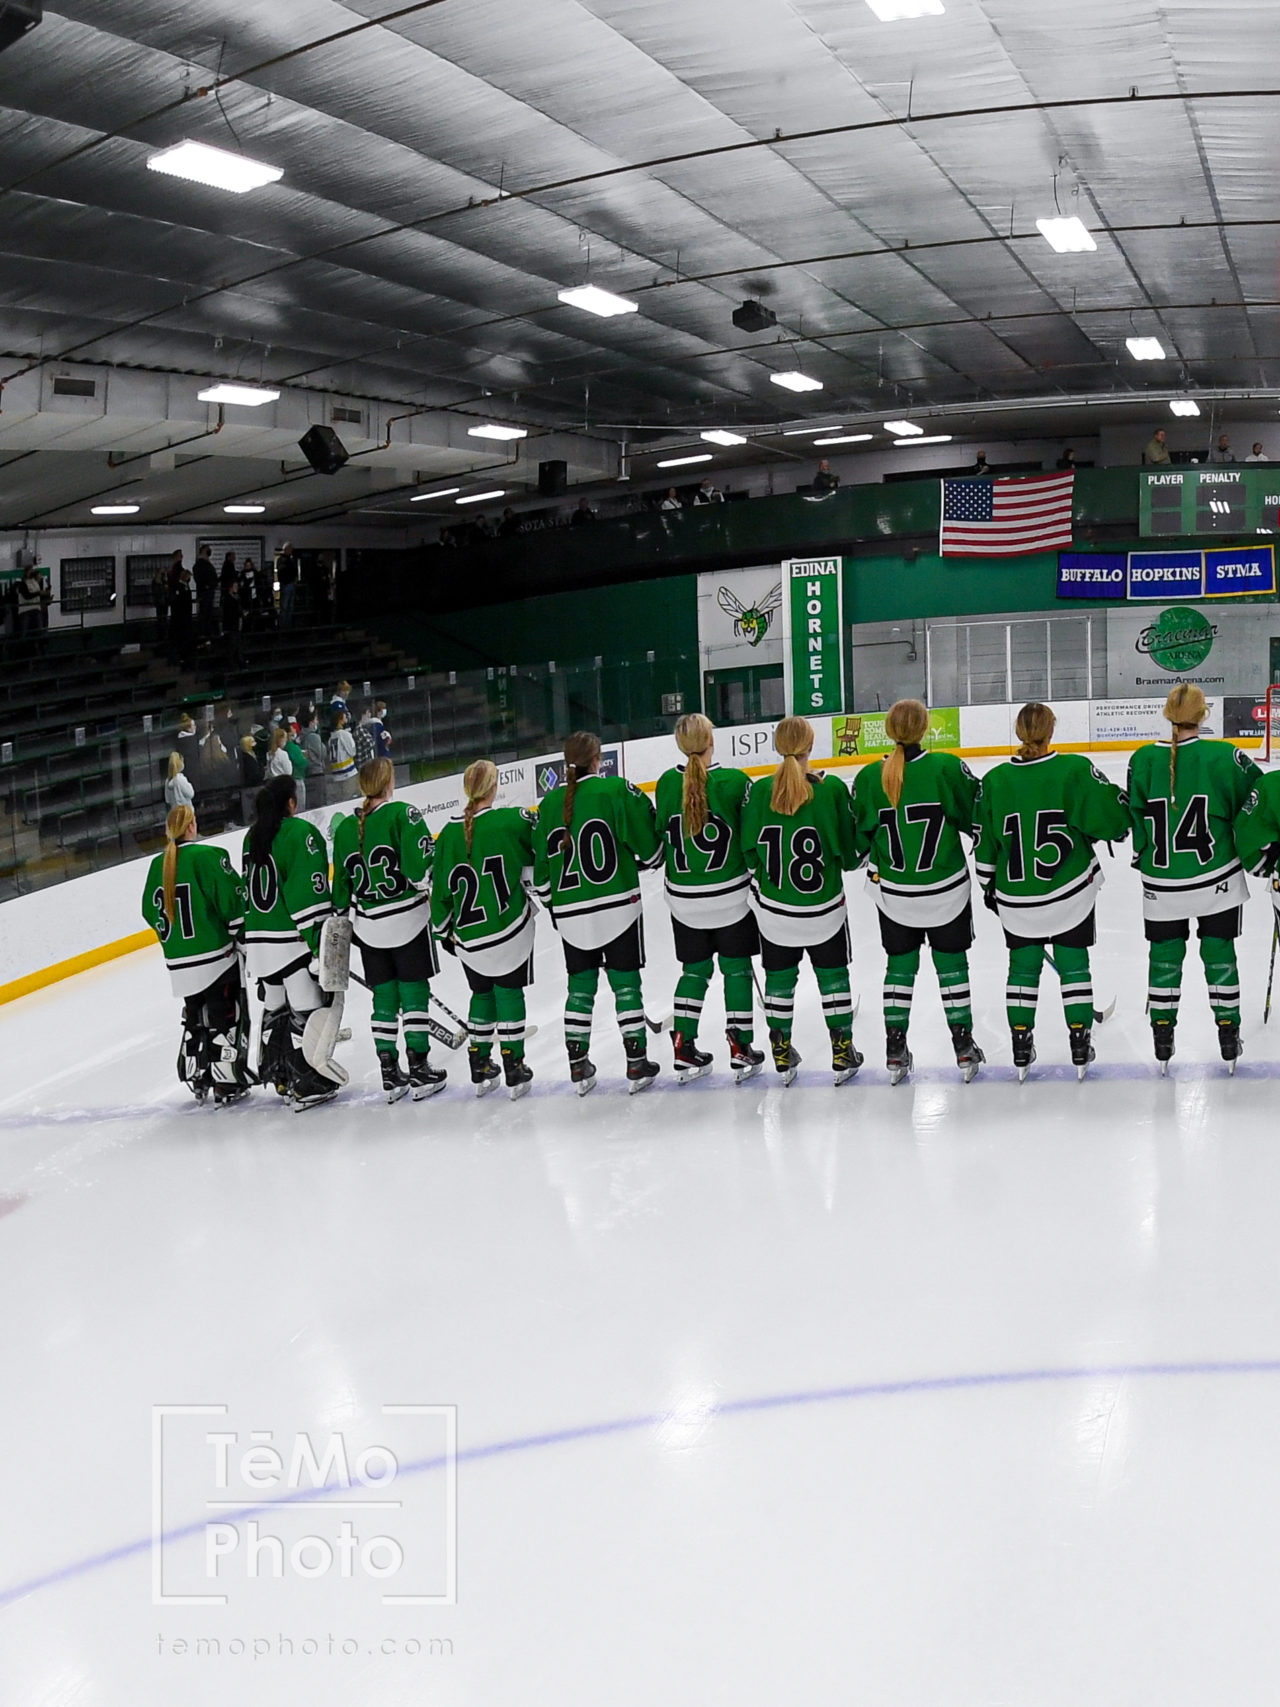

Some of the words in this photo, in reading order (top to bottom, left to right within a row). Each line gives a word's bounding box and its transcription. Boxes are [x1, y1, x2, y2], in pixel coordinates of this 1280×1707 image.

[1148, 474, 1183, 485] PLAYER
[1200, 473, 1240, 483] PENALTY
[792, 561, 836, 578] EDINA
[1061, 568, 1123, 582] BUFFALO
[1131, 567, 1200, 582] HOPKINS
[1216, 563, 1262, 579] STMA
[806, 581, 824, 708] HORNETS
[1135, 625, 1219, 653] Braemar
[1136, 677, 1225, 685] BraemarArena.com
[500, 767, 525, 786] ESTIN
[666, 811, 733, 873] 19
[879, 802, 945, 872] 17
[1003, 809, 1074, 882] 15
[1144, 794, 1216, 868] 14
[345, 845, 409, 900] 23
[547, 818, 618, 892] 20
[758, 825, 825, 893] 18
[450, 855, 511, 929] 21
